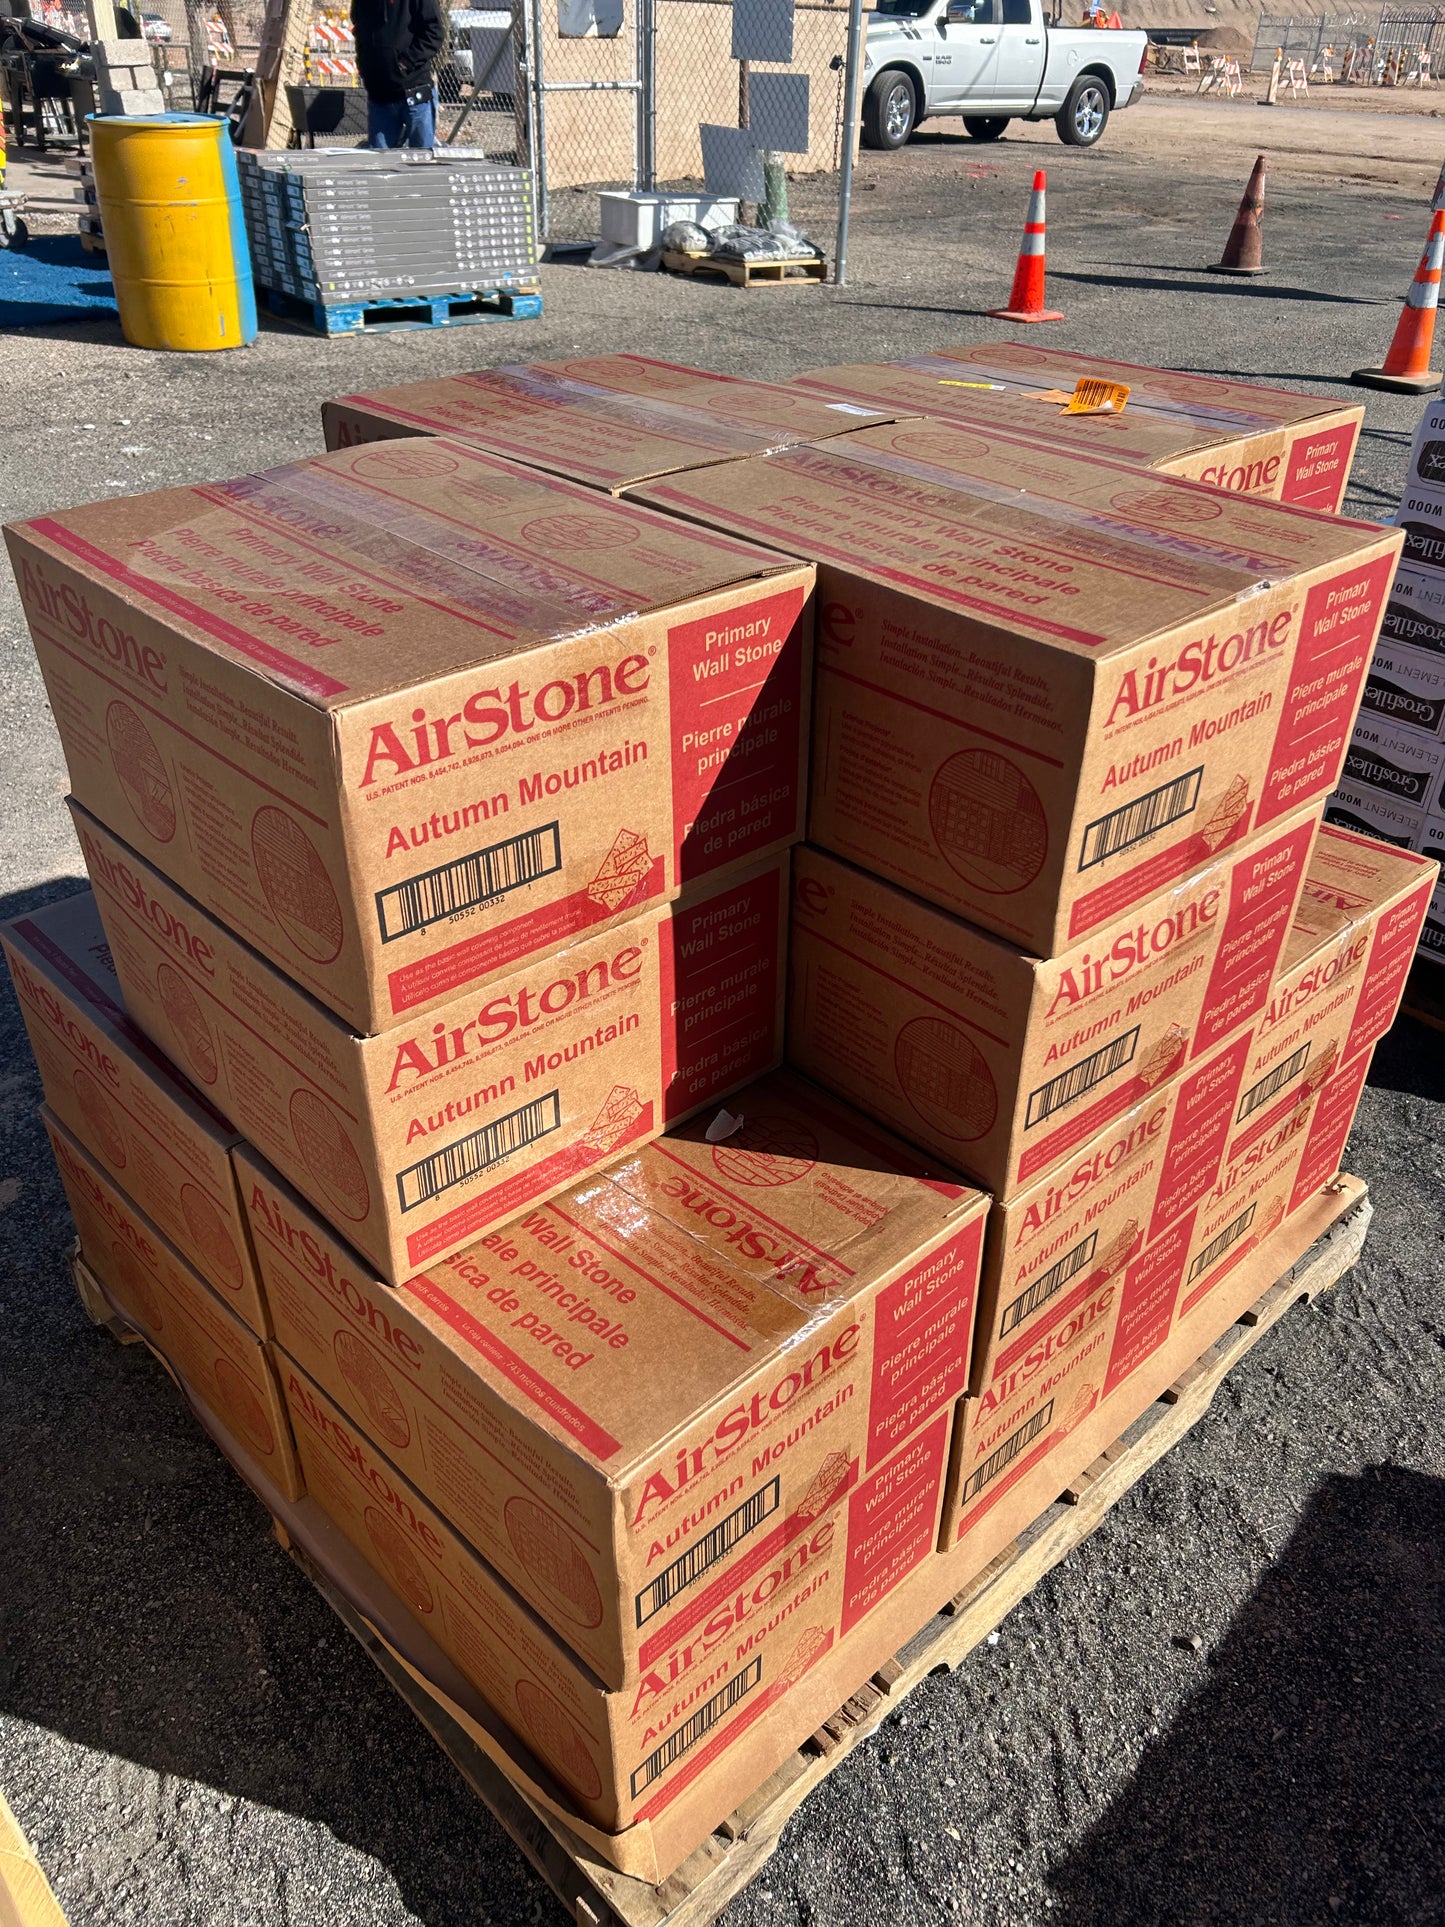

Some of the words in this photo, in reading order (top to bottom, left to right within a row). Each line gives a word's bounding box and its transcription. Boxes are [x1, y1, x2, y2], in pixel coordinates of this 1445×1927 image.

[1295, 463, 1315, 482] Wall
[1315, 457, 1340, 476] Stone
[1305, 441, 1339, 458] Primary
[1408, 498, 1443, 517] WOOD
[757, 504, 834, 534] Piedra
[834, 531, 918, 564] básica
[922, 562, 958, 578] de
[954, 575, 1051, 605] pared
[781, 495, 850, 521] Pierre
[852, 520, 940, 551] murale
[938, 549, 1081, 596] principale
[836, 495, 931, 529] Primary
[933, 525, 995, 549] Wall
[993, 545, 1075, 574] Stone
[127, 539, 188, 573] Piedra
[181, 569, 248, 603] básica
[240, 599, 273, 617] de
[261, 614, 342, 649] pared
[167, 527, 222, 559] Pierre
[220, 555, 286, 590] murale
[276, 587, 385, 637] principale
[226, 528, 302, 566] Primary
[302, 561, 350, 586] Wall
[337, 582, 405, 613] Stone
[1325, 578, 1371, 611] Primary
[705, 615, 771, 653] Primary
[1313, 613, 1338, 638] Wall
[1339, 598, 1372, 624] Stone
[693, 653, 729, 683] Wall
[735, 638, 783, 668] Stone
[880, 635, 928, 664] Installation
[881, 618, 910, 640] Simple
[1012, 668, 1050, 692] Results.
[1394, 663, 1445, 687] LEMENT
[1290, 675, 1324, 704] Pierre
[1326, 654, 1363, 684] murale
[1293, 682, 1348, 727] principale
[682, 720, 732, 754] Pierre
[737, 698, 793, 733] murale
[1013, 704, 1064, 736] Hermosos.
[1101, 730, 1182, 795] Autumn
[1190, 690, 1273, 748] Mountain
[1354, 727, 1380, 744] WOO
[382, 780, 409, 795] PATENT
[526, 731, 541, 744] ONE
[552, 722, 572, 735] MORE
[573, 715, 595, 729] OTHER
[697, 727, 778, 777] principale
[1270, 756, 1305, 788] Piedra
[1307, 736, 1342, 765] básica
[1347, 755, 1420, 794] Grosfillex
[1380, 738, 1440, 764] ELEMENT
[386, 791, 509, 858] Autumn
[519, 740, 648, 806] Mountain
[1277, 782, 1291, 801] de
[1293, 761, 1326, 794] pared
[683, 807, 736, 842] Piedra
[703, 835, 723, 856] de
[728, 811, 772, 845] pared
[1363, 801, 1419, 829] ELEMENT
[1242, 880, 1266, 904] Wall
[1266, 859, 1297, 889] Stone
[1252, 844, 1294, 880] Primary
[448, 908, 476, 925] 50552
[479, 894, 505, 911] 00332
[1219, 928, 1253, 959] Pierre
[1254, 903, 1289, 934] murale
[1223, 927, 1276, 974] principale
[1043, 1008, 1120, 1068] Autumn
[1125, 953, 1205, 1018] Mountain
[1203, 992, 1237, 1025] Piedra
[1211, 1015, 1225, 1033] de
[1226, 993, 1256, 1026] pared
[1253, 1029, 1301, 1075] Autumn
[1302, 984, 1356, 1034] Mountain
[406, 1075, 515, 1145] Autumn
[524, 1012, 640, 1083] Mountain
[1201, 1194, 1246, 1243] Autumn
[1248, 1146, 1299, 1198] Mountain
[1014, 1220, 1081, 1287] Autumn
[1083, 1158, 1155, 1227] Mountain
[521, 1211, 577, 1255] Wall
[568, 1249, 637, 1305] Stone
[904, 1247, 957, 1297] Primary
[441, 1251, 490, 1290] sica
[486, 1284, 521, 1314] de
[509, 1310, 596, 1371] pared
[480, 1233, 519, 1262] ale
[509, 1258, 630, 1351] principale
[892, 1288, 922, 1322] Wall
[926, 1258, 965, 1296] Stone
[880, 1335, 921, 1377] Pierre
[924, 1294, 969, 1338] murale
[890, 1320, 956, 1387] principale
[519, 1370, 547, 1398] metros
[875, 1392, 918, 1438] Piedra
[921, 1355, 962, 1396] básica
[973, 1396, 1035, 1461] Autumn
[1038, 1329, 1106, 1399] Mountain
[889, 1419, 907, 1440] de
[909, 1382, 946, 1425] pared
[645, 1474, 744, 1569] Autumn
[751, 1383, 855, 1478] Mountain
[640, 1660, 729, 1751] Autumn
[735, 1568, 830, 1663] Mountain
